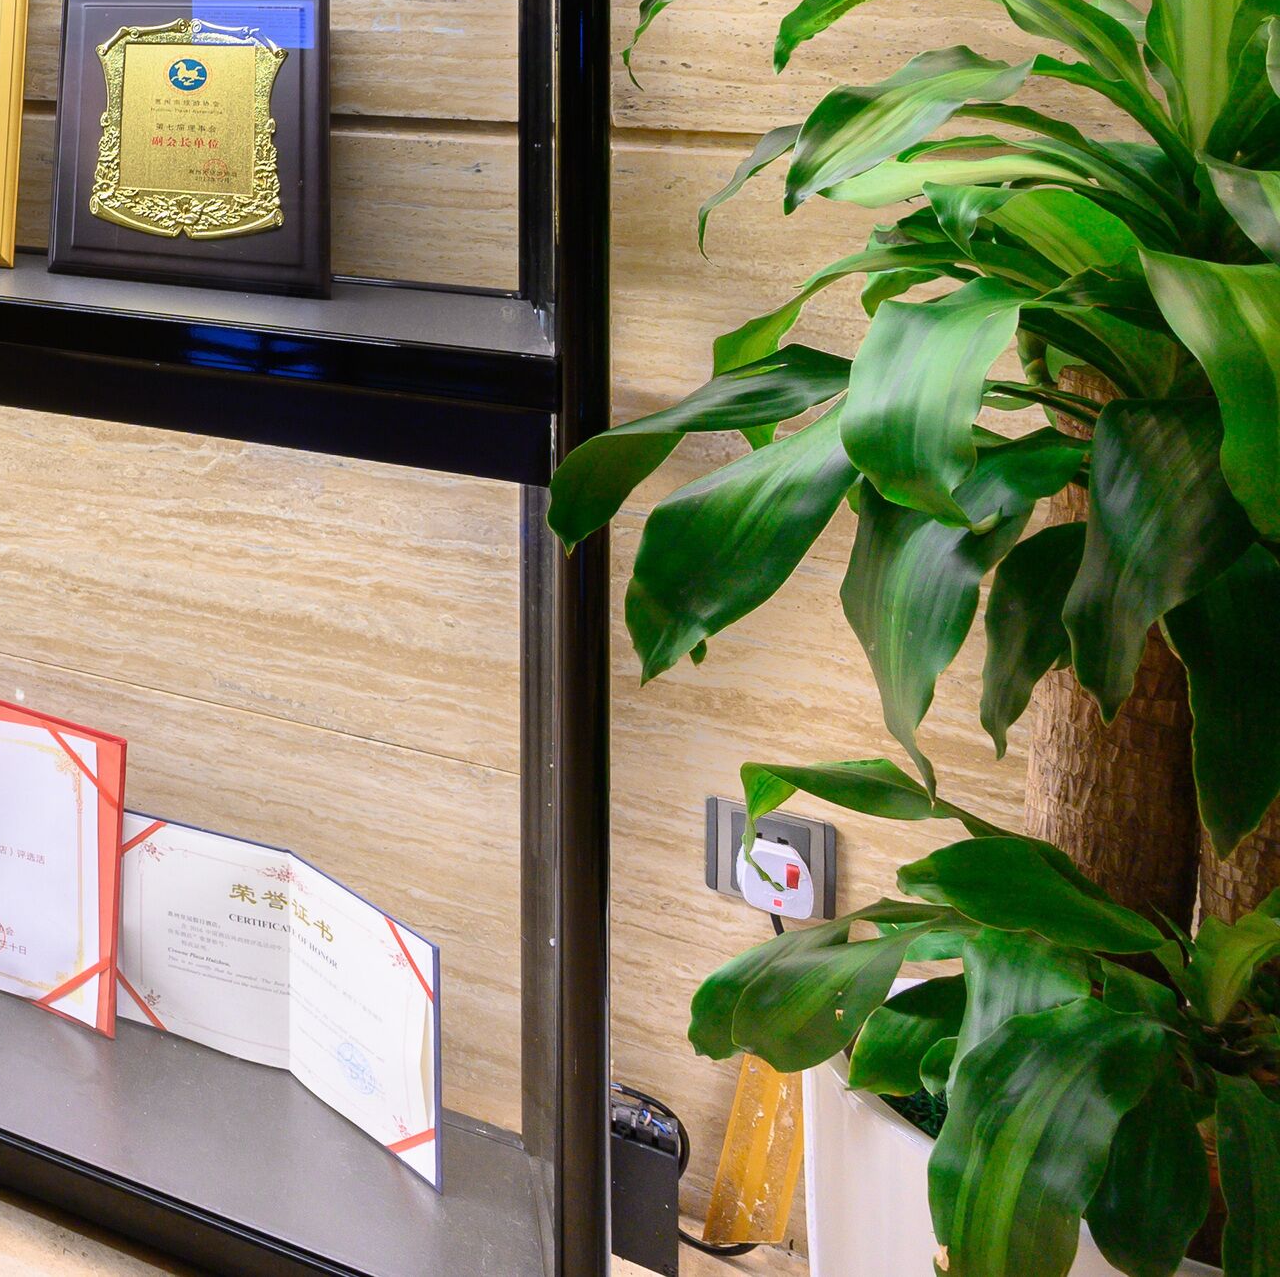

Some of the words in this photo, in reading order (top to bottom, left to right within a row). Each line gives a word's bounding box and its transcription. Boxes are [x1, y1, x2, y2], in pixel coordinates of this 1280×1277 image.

[156, 123, 217, 133] 第七届理事会
[151, 136, 219, 149] 副会长单位
[229, 883, 334, 943] 荣誉证书
